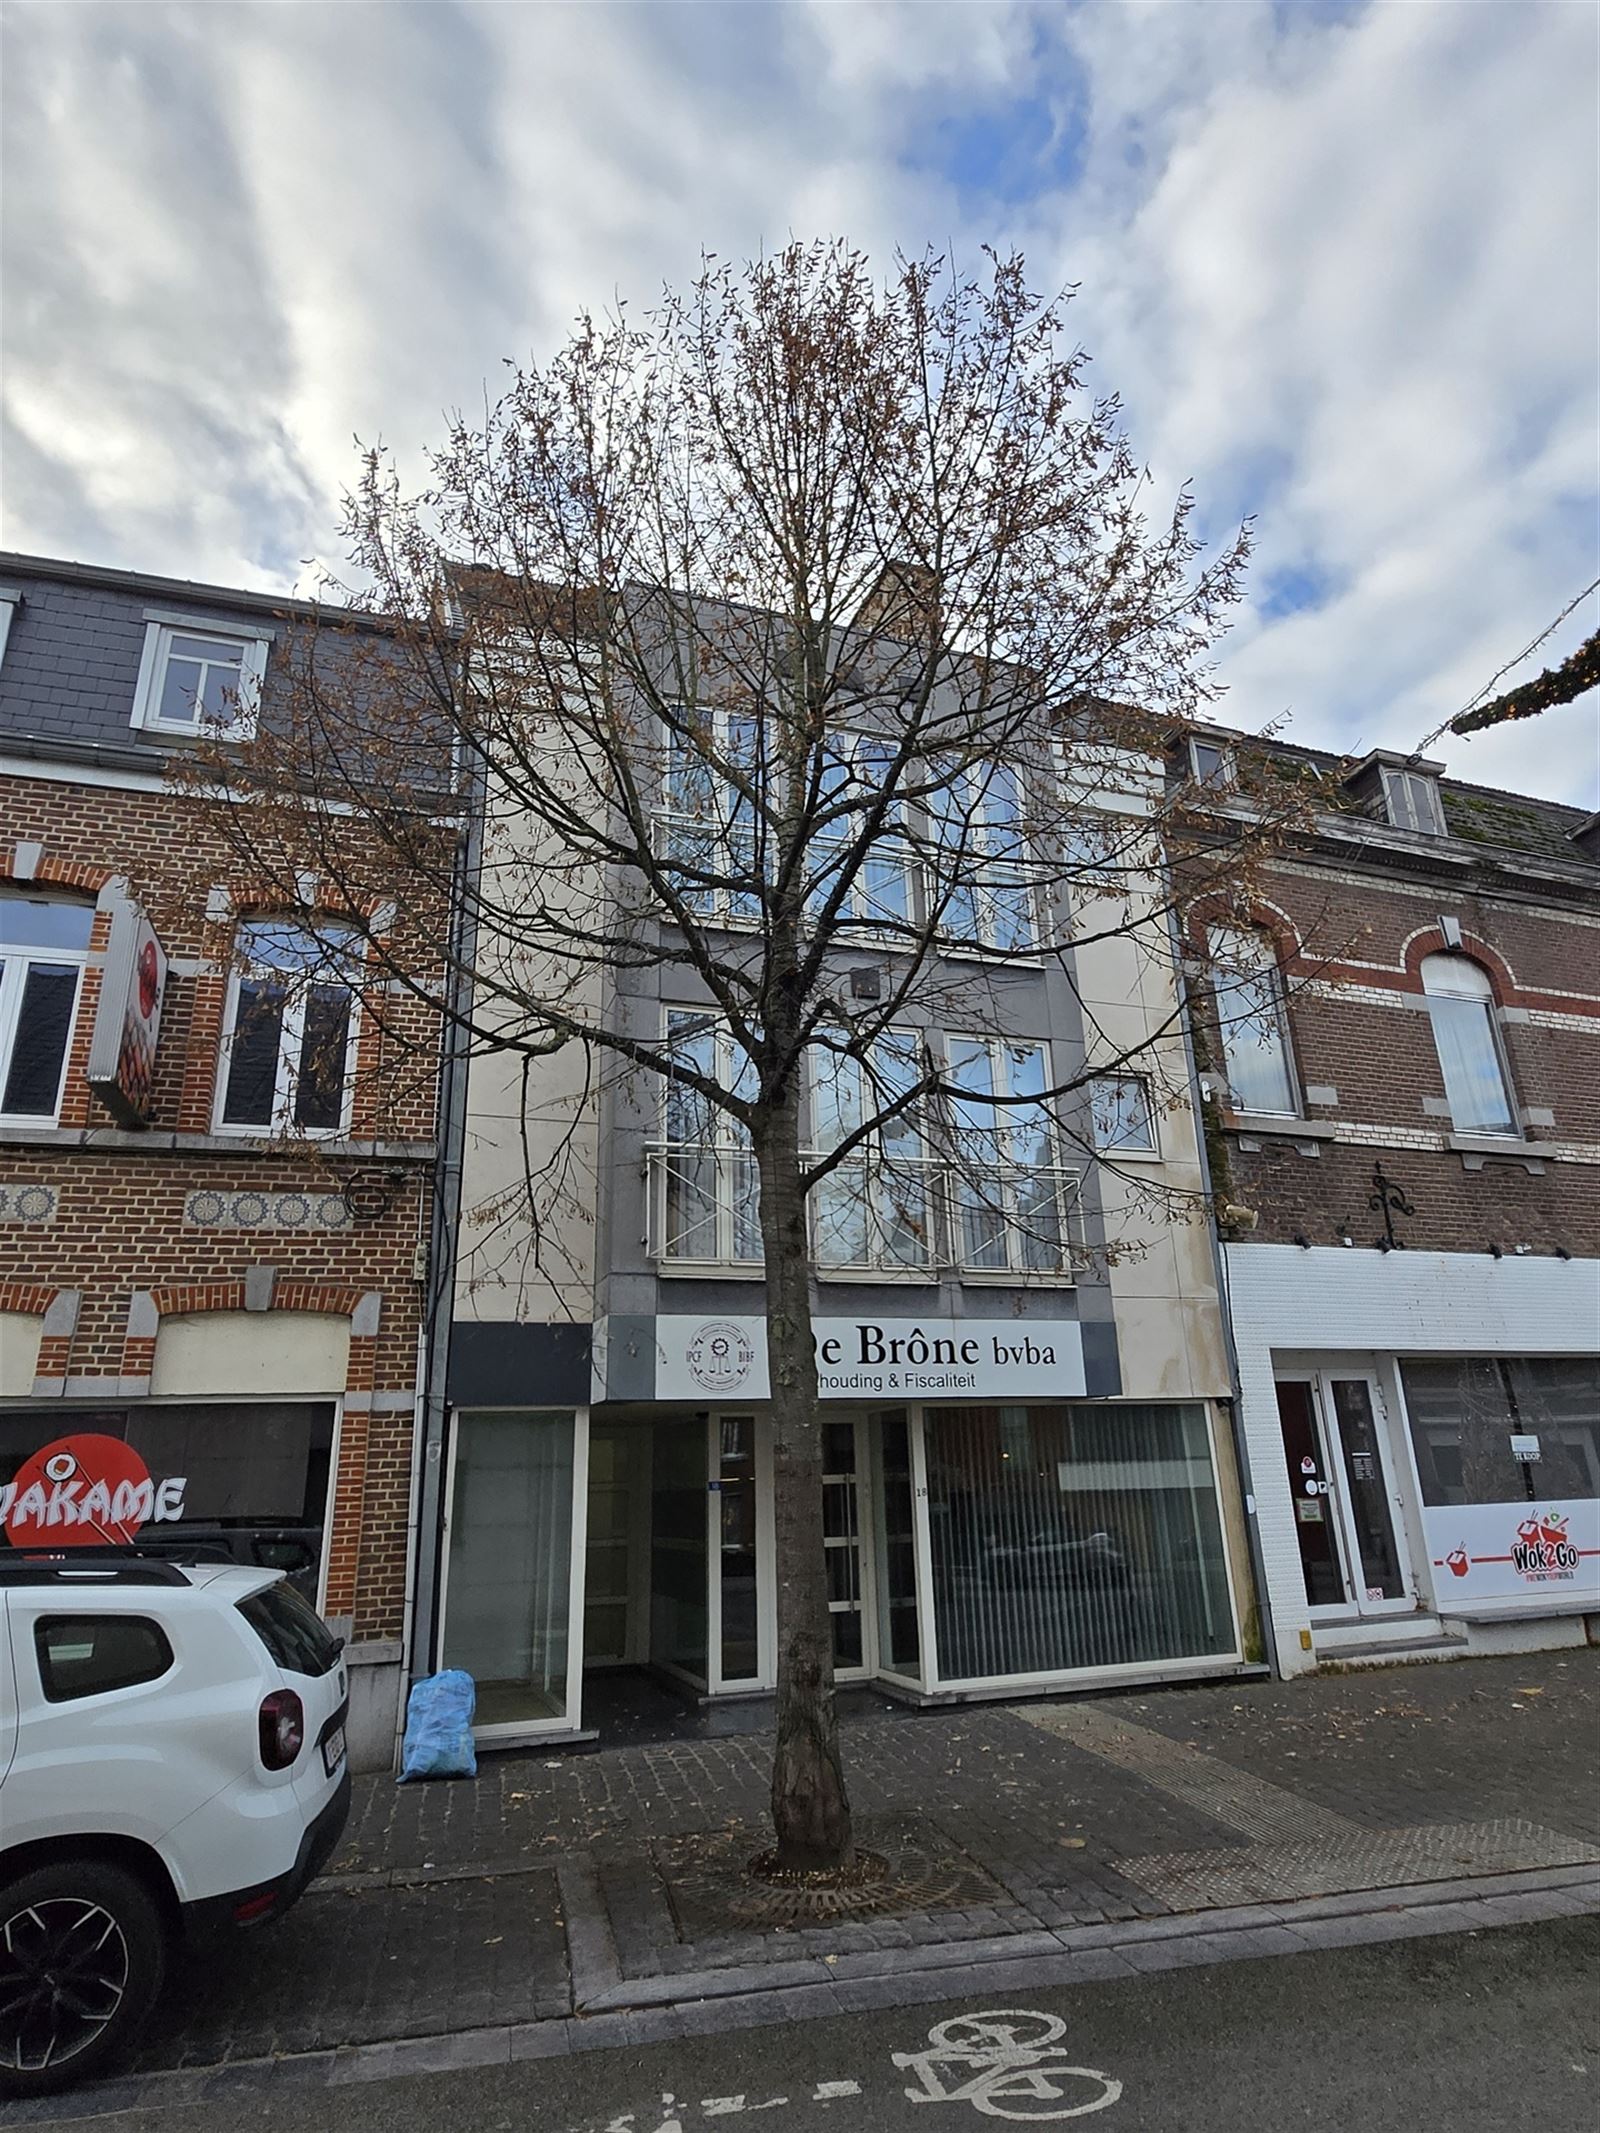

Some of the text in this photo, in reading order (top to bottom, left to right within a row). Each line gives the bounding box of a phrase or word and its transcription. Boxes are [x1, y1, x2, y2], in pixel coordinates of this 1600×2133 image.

[812, 1325, 1056, 1365] e Brône bvba
[888, 1373, 900, 1388] &
[904, 1372, 976, 1388] Fiscaliteit
[916, 1487, 927, 1497] 18
[1513, 1541, 1577, 1570] Wok2Go
